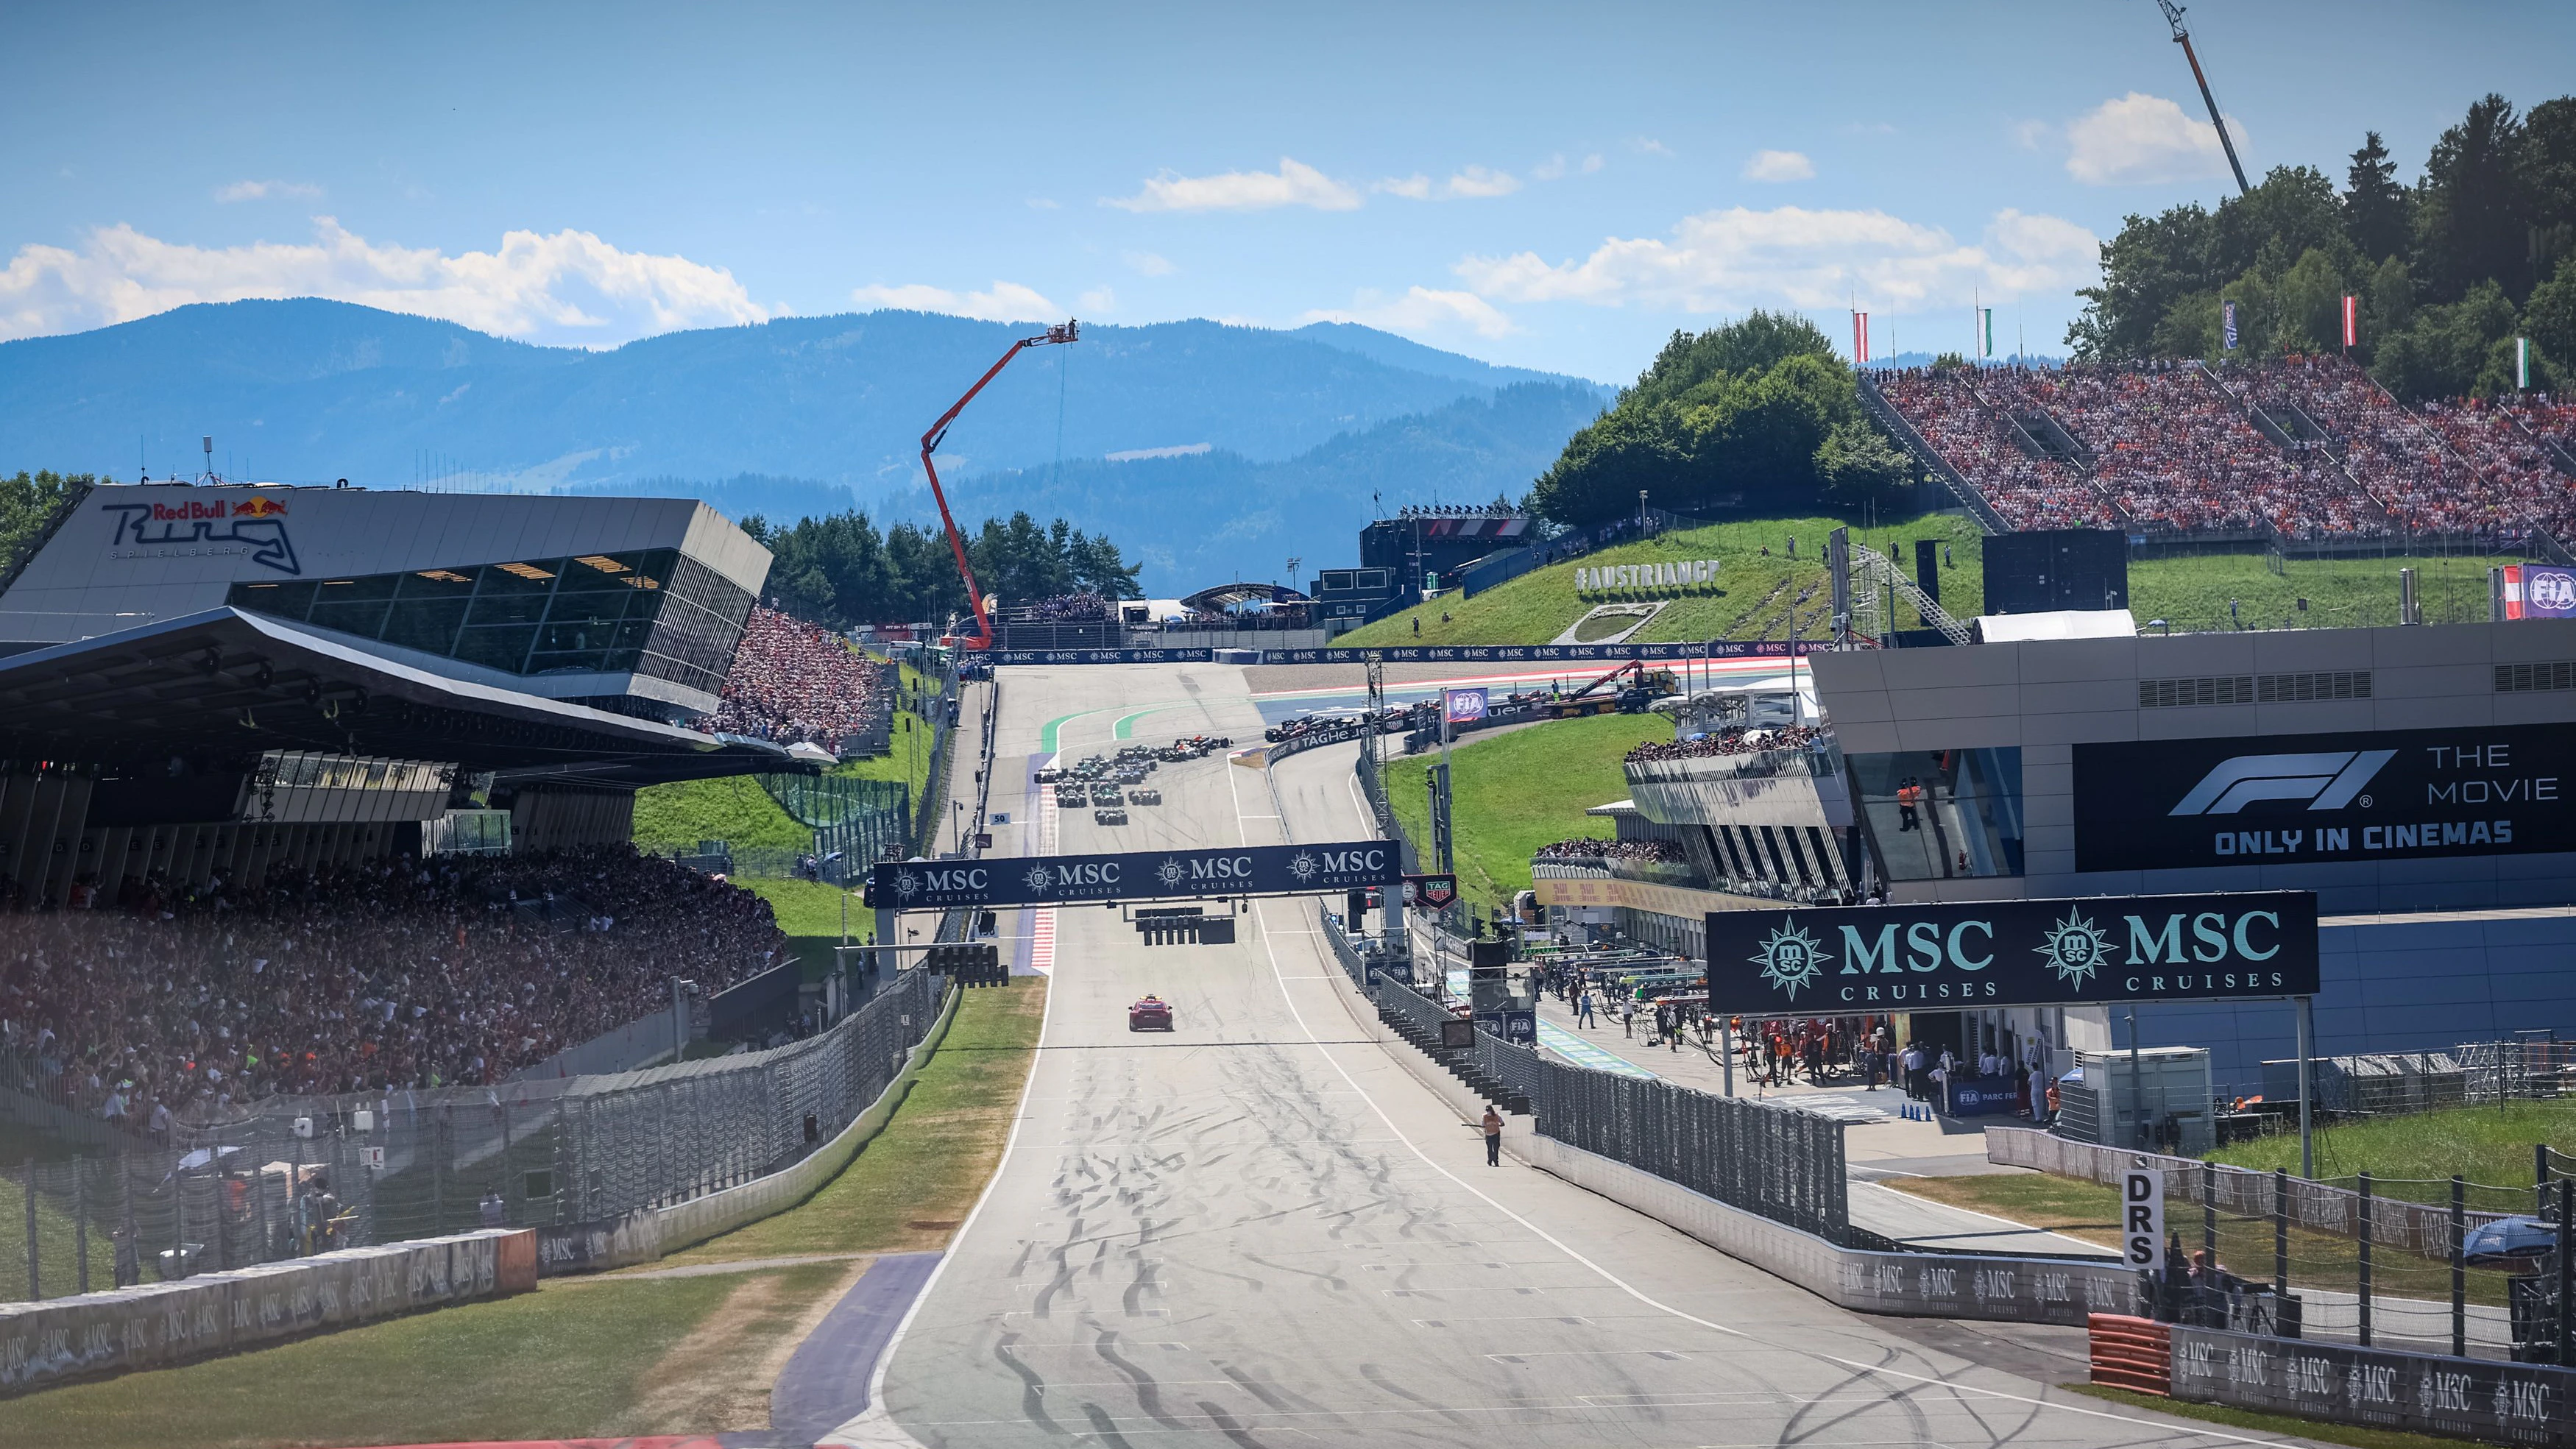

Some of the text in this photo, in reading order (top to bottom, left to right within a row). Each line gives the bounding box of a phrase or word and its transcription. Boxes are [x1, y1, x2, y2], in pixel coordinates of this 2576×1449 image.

[154, 500, 224, 520] Red Bull
[111, 546, 248, 559] SPIELBERG
[1575, 560, 1720, 592] #AUSTRIANGP
[1186, 650, 1206, 659] MSC
[1402, 649, 1418, 657] MSC
[1437, 649, 1454, 657] MSC
[1472, 648, 1488, 656] MSC
[1507, 648, 1524, 656] MSC
[1543, 648, 1560, 656] MSC
[1578, 648, 1595, 656] MSC
[1613, 647, 1631, 655] MSC
[1649, 646, 1667, 655] MSC
[1725, 644, 1744, 653] MSC
[1766, 643, 1786, 652] MSC
[1013, 653, 1034, 661] MSC
[1056, 652, 1077, 660] MSC
[1100, 651, 1121, 659] MSC
[1143, 651, 1164, 659] MSC
[1272, 652, 1285, 660] MSC
[1301, 651, 1316, 659] MSC
[1334, 651, 1350, 659] MSC
[2427, 744, 2510, 769] THE
[2167, 749, 2399, 816] F1
[2428, 778, 2558, 805] MOVIE
[994, 815, 1005, 823] 50
[2215, 820, 2512, 855] ONLY IN CINEMAS
[1190, 857, 1252, 879] MSC
[1322, 850, 1384, 873] MSC
[925, 868, 988, 891] MSC
[1058, 862, 1120, 885] MSC
[1323, 874, 1386, 883] CRUISES
[1059, 887, 1121, 896] CRUISES
[1191, 881, 1253, 890] CRUISES
[927, 893, 988, 902] CRUISES
[1428, 890, 1449, 901] HEUER
[2123, 910, 2280, 965] MSC
[1838, 920, 1994, 974] MSC
[2126, 972, 2282, 991] CRUISES
[1841, 982, 1996, 1001] CRUISES
[1983, 1092, 2003, 1101] PARC
[2005, 1091, 2018, 1100] FER
[2128, 1175, 2154, 1264] DRS
[553, 1238, 575, 1261] MSC
[1882, 1265, 1903, 1294] MSC
[1931, 1269, 1958, 1296] MSC
[1988, 1271, 2016, 1299] MSC
[2046, 1273, 2070, 1302] MSC
[2095, 1277, 2115, 1308] MSC
[7, 1336, 28, 1370] MSC
[2190, 1342, 2214, 1378] MSC
[2241, 1347, 2268, 1386] MSC
[2301, 1356, 2330, 1395] MSC
[2364, 1364, 2396, 1404] MSC
[2435, 1372, 2471, 1412] MSC
[2513, 1380, 2550, 1422] MSC
[2363, 1410, 2396, 1424] CRUISES
[2435, 1419, 2471, 1432] CRUISES
[2512, 1429, 2549, 1443] CRUISES
